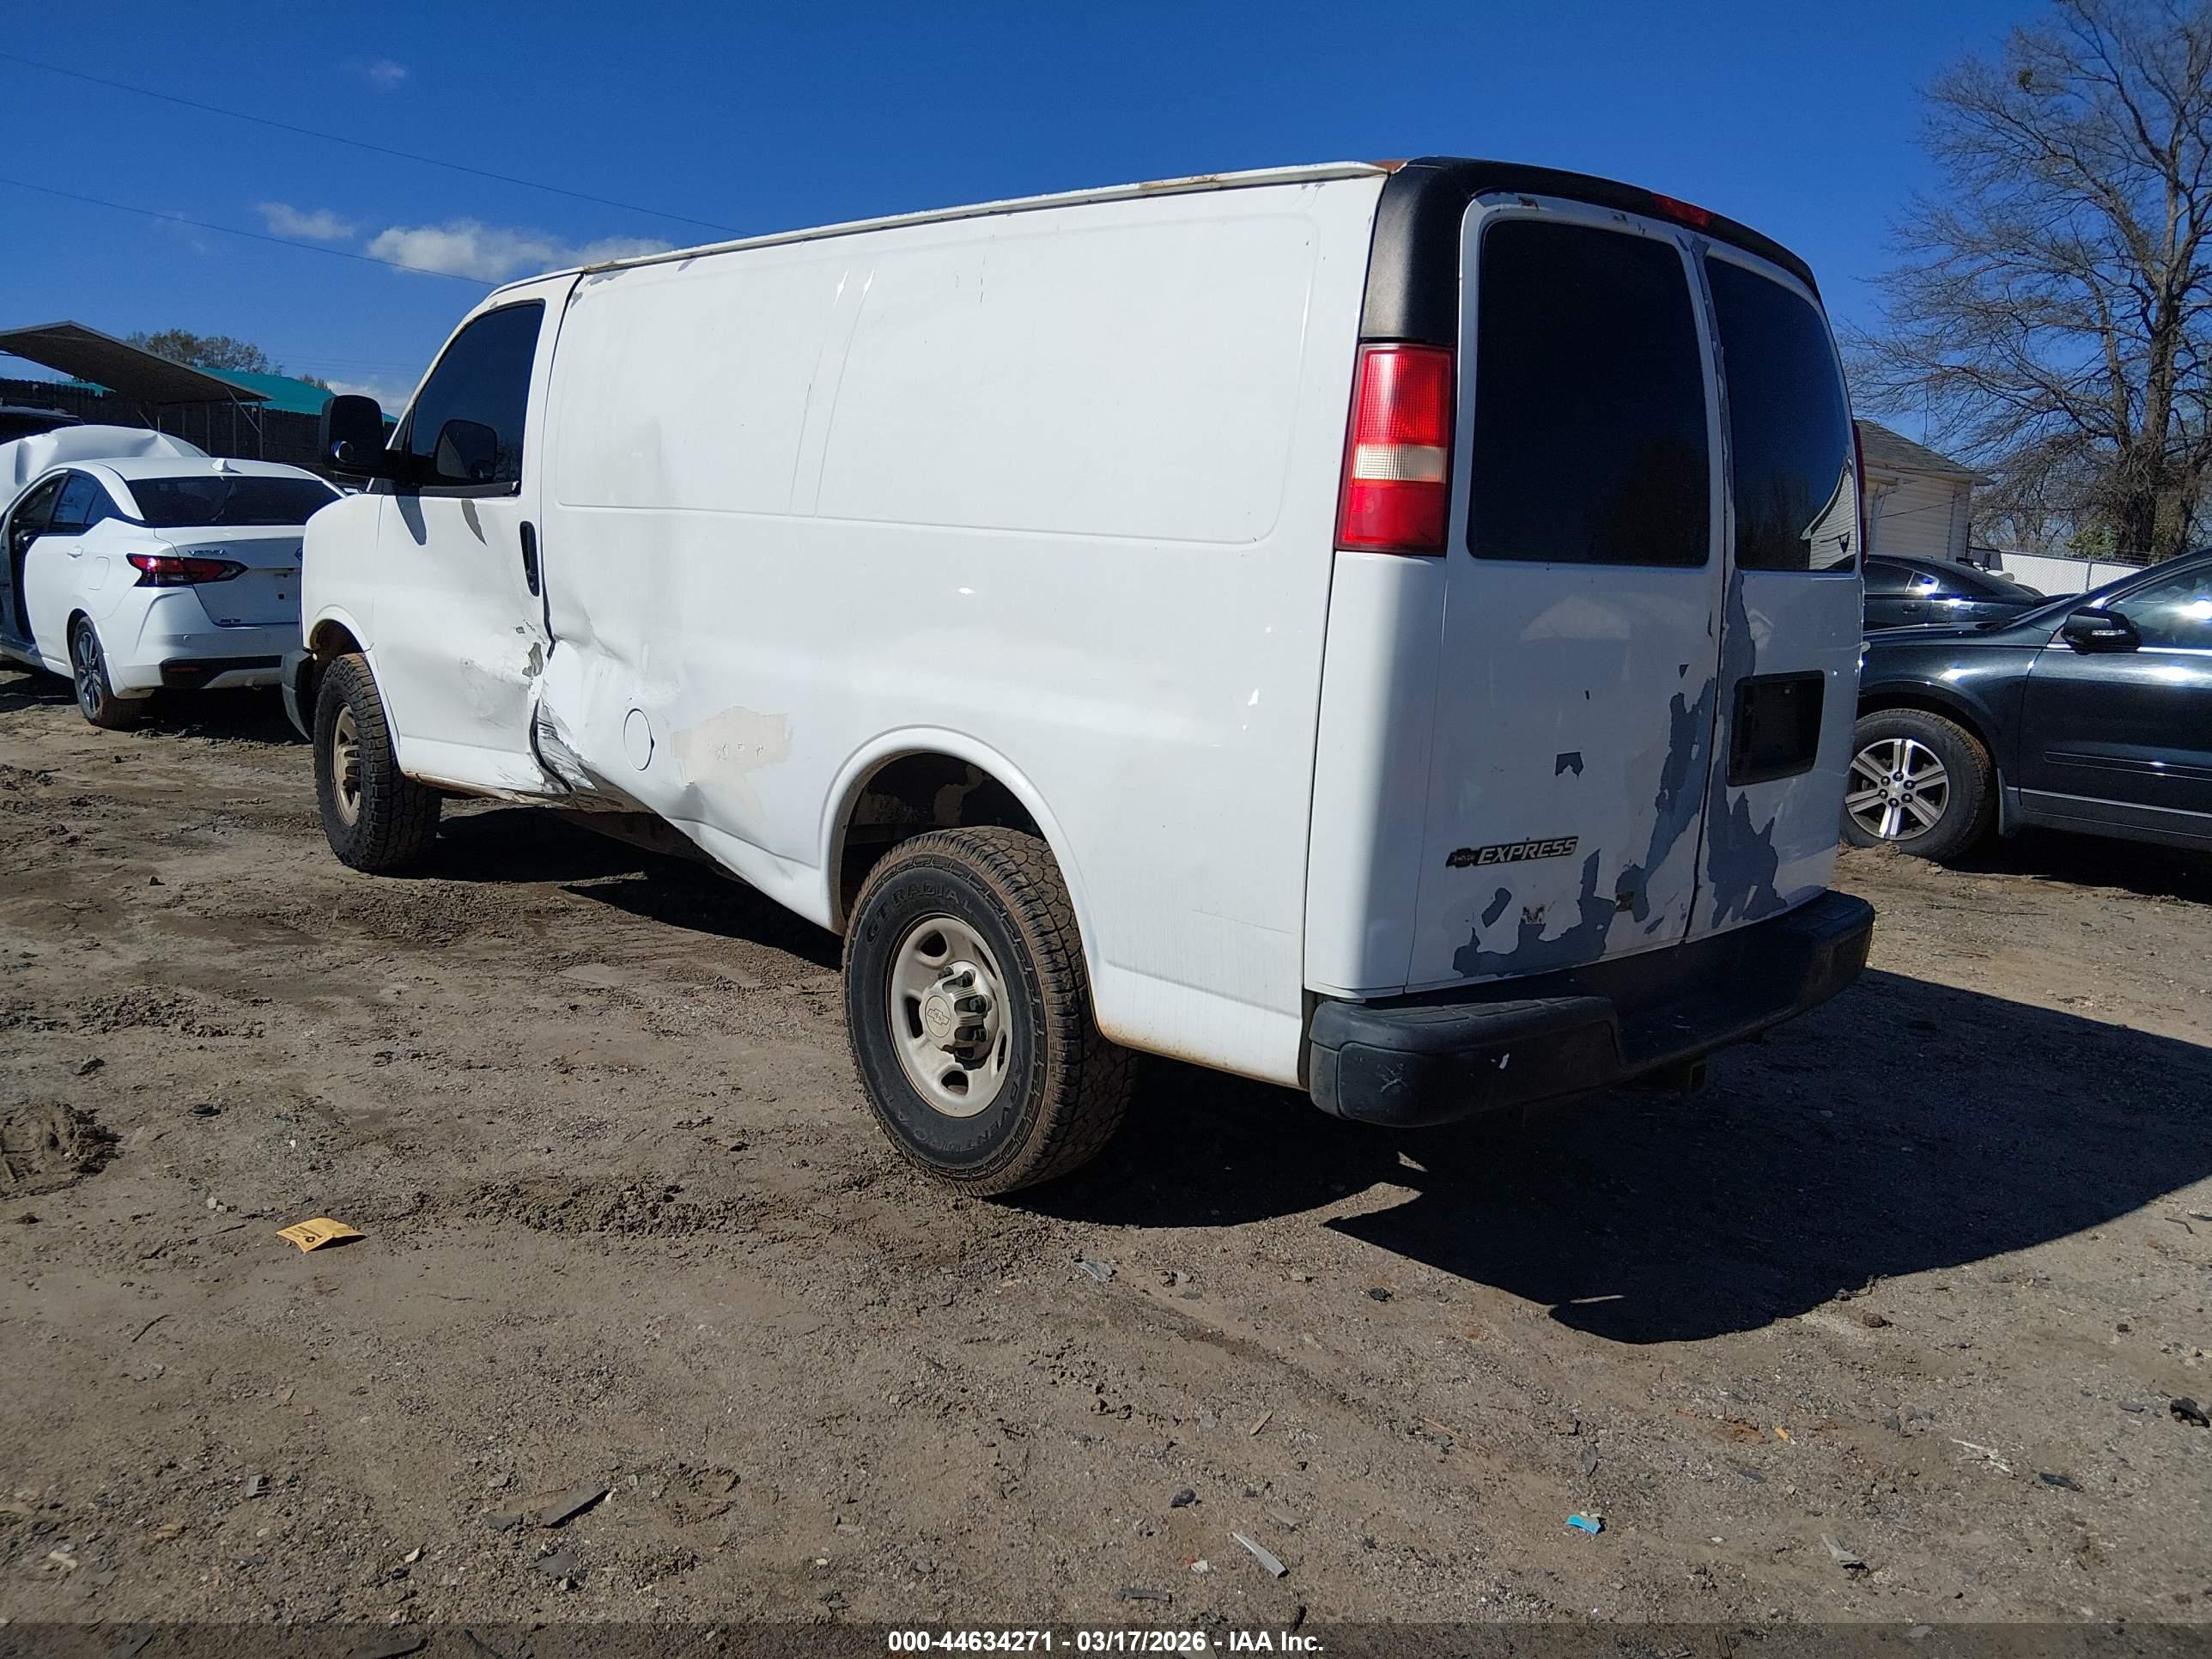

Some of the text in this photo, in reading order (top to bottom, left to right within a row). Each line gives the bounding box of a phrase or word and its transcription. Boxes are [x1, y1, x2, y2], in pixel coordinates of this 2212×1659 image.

[1476, 838, 1578, 865] EXPRESS
[866, 880, 974, 944] GT RADIAL
